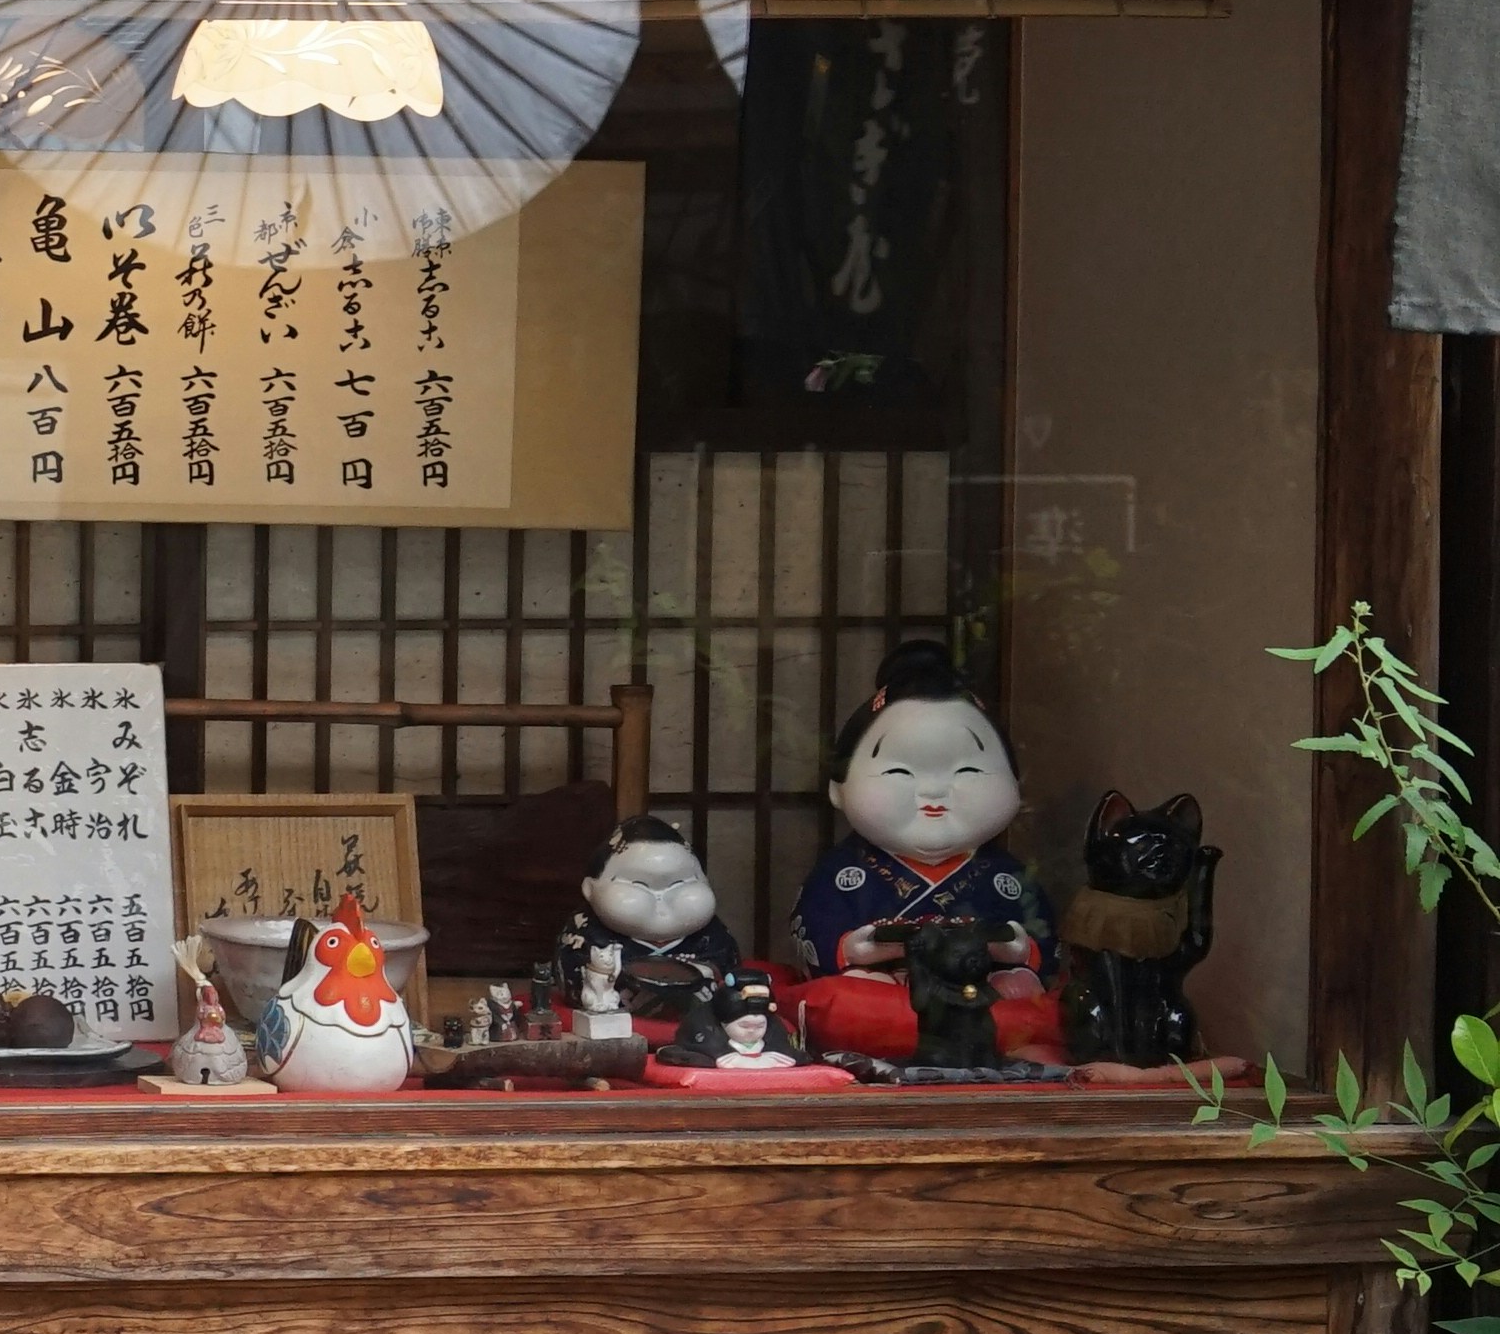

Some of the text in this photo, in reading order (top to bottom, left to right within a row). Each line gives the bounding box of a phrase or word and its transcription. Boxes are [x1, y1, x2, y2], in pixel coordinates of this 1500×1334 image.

[23, 194, 74, 484] 亀山 八百円
[104, 364, 145, 486] 六百五拾円
[180, 365, 220, 486] 六百五拾円
[260, 367, 298, 485] 六百五拾円
[334, 369, 376, 490] 七百円
[414, 369, 454, 488] 六百五拾円
[88, 894, 119, 1022] 六百五拾円
[121, 893, 154, 1022] 五百五拾円
